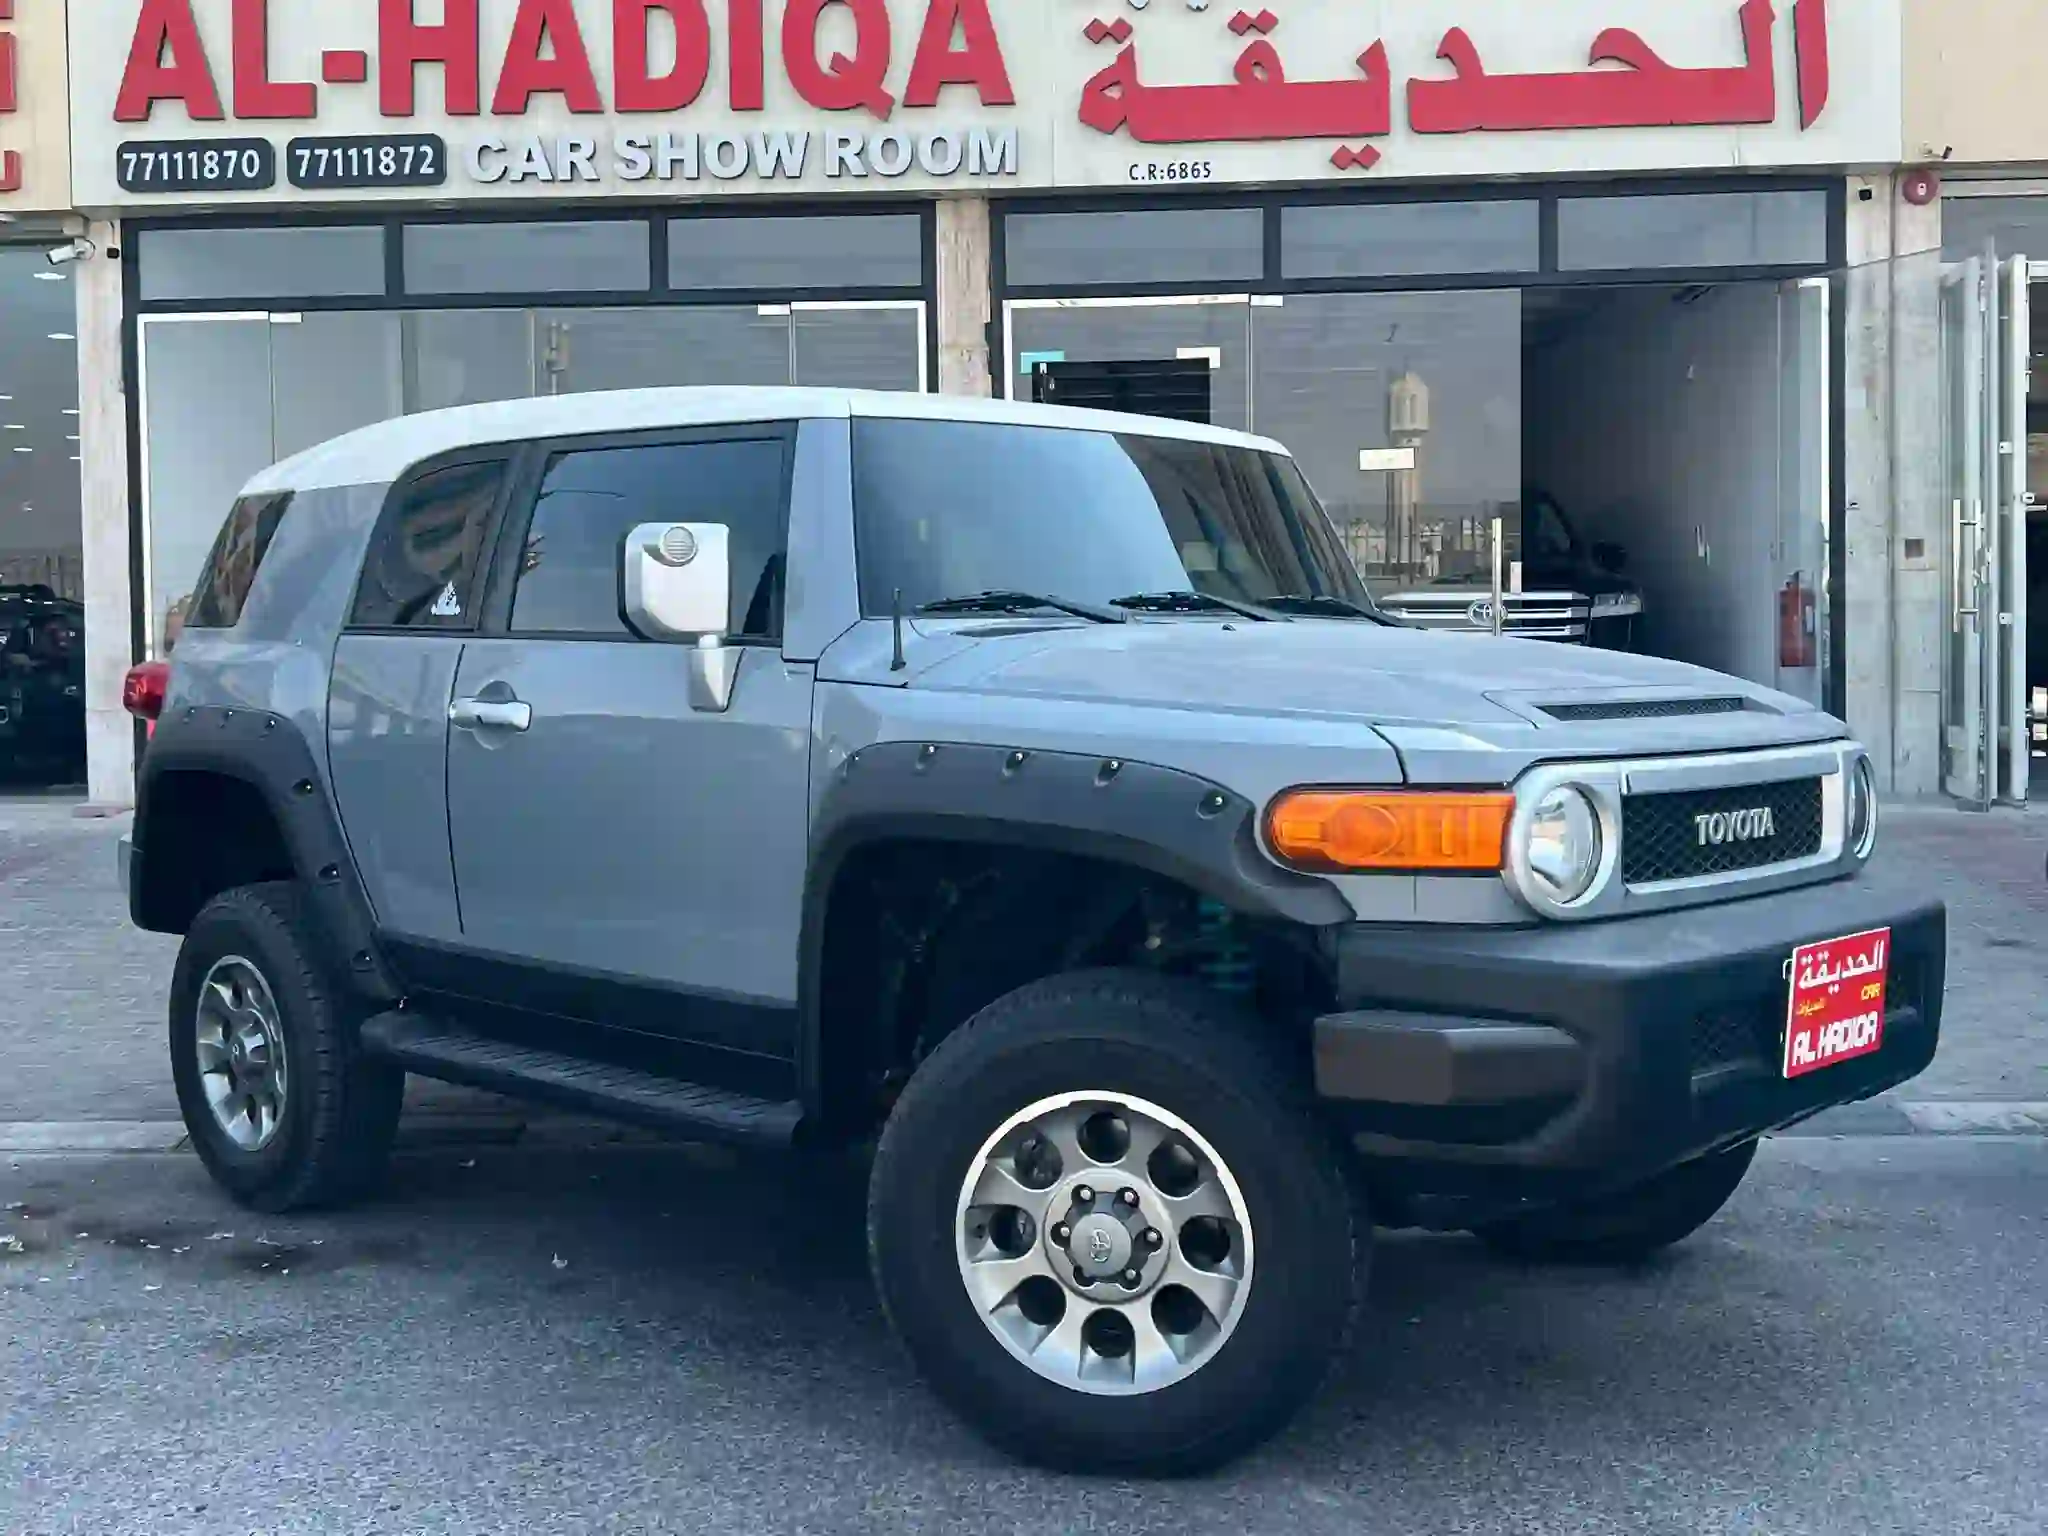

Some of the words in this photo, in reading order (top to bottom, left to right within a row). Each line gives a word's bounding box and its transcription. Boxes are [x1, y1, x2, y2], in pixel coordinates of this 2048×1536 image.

[114, 0, 1014, 120] AL-HADIQA
[1079, 0, 1829, 170] الحديقة
[122, 150, 261, 183] 77111870
[295, 146, 437, 177] 77111872
[466, 136, 600, 182] CAR
[614, 131, 810, 180] SHOW
[826, 127, 1018, 177] ROOM
[1129, 162, 1212, 181] C.R:6865
[1695, 806, 1776, 846] TOYOTA
[1799, 940, 1884, 995] الحديقة
